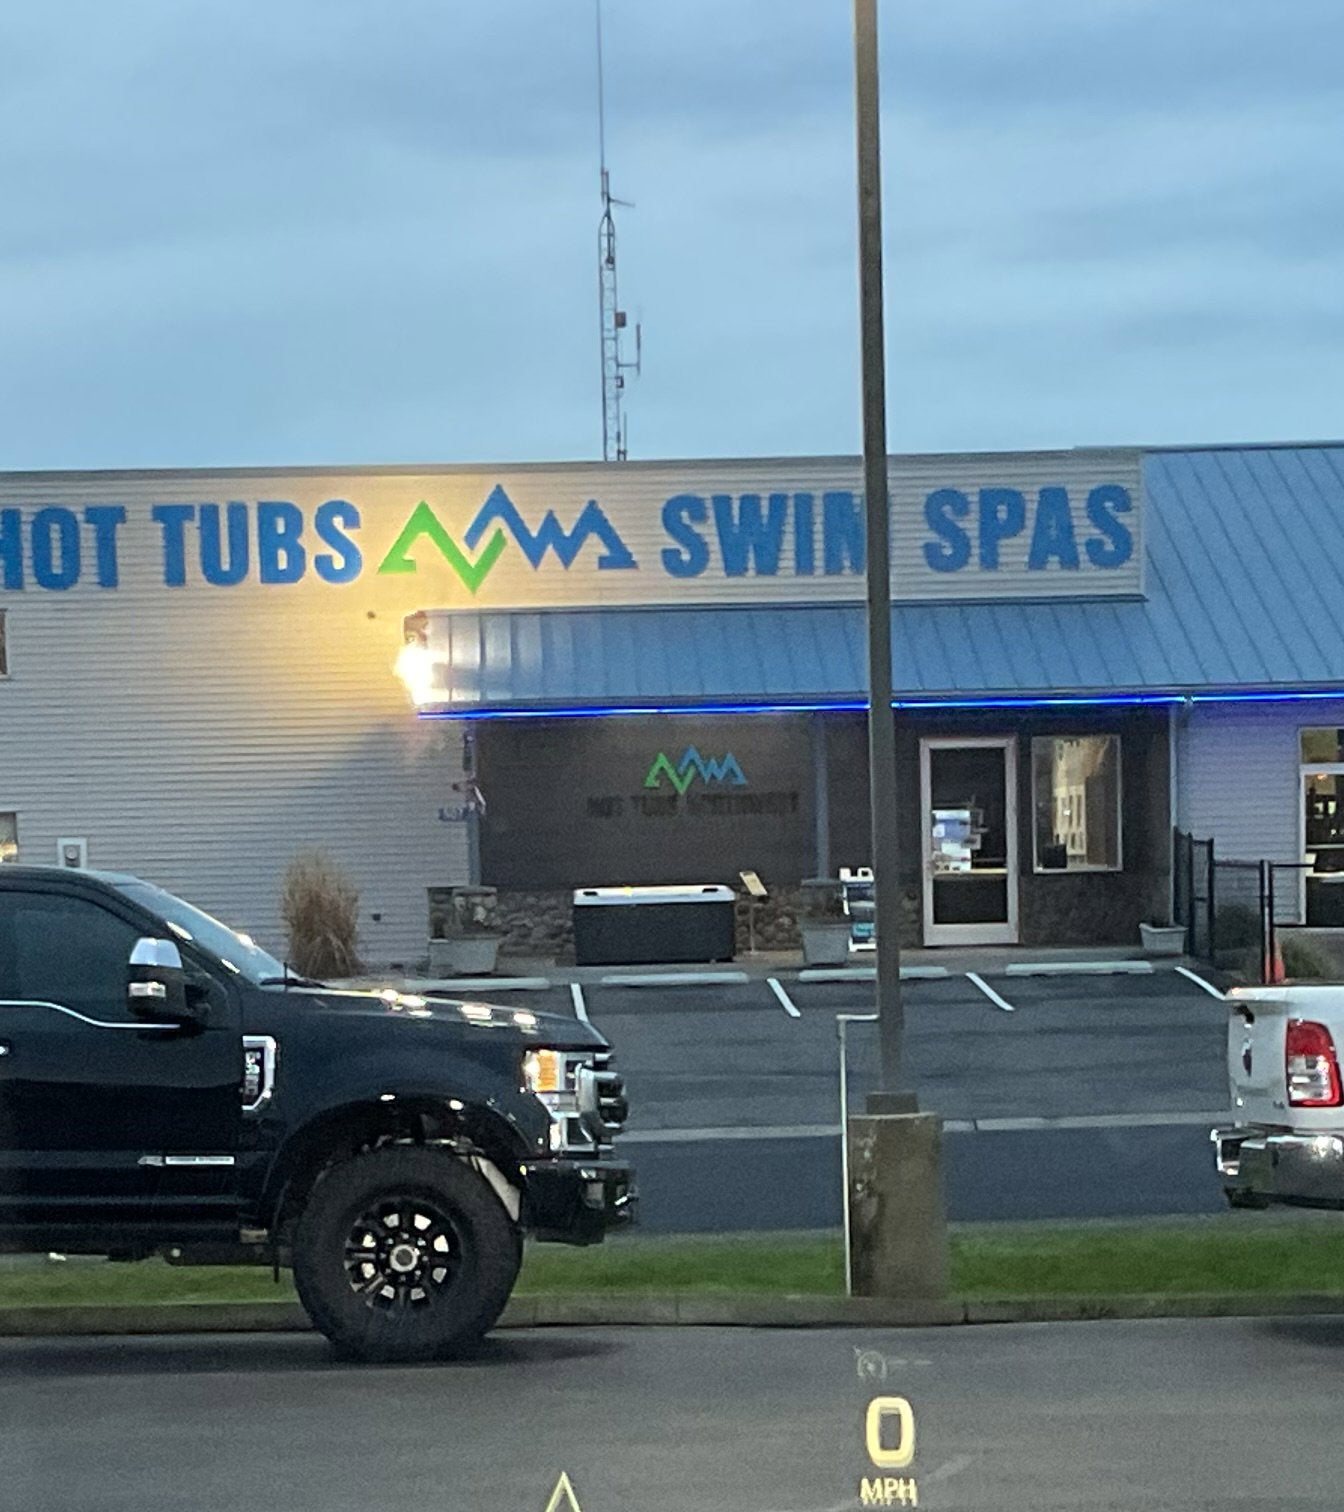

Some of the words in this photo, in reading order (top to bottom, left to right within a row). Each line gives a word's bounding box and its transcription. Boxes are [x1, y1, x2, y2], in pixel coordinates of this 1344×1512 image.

[152, 500, 362, 588] TUBS
[923, 484, 1133, 573] SPAS
[866, 1396, 915, 1468] 0
[860, 1477, 918, 1506] MPH
